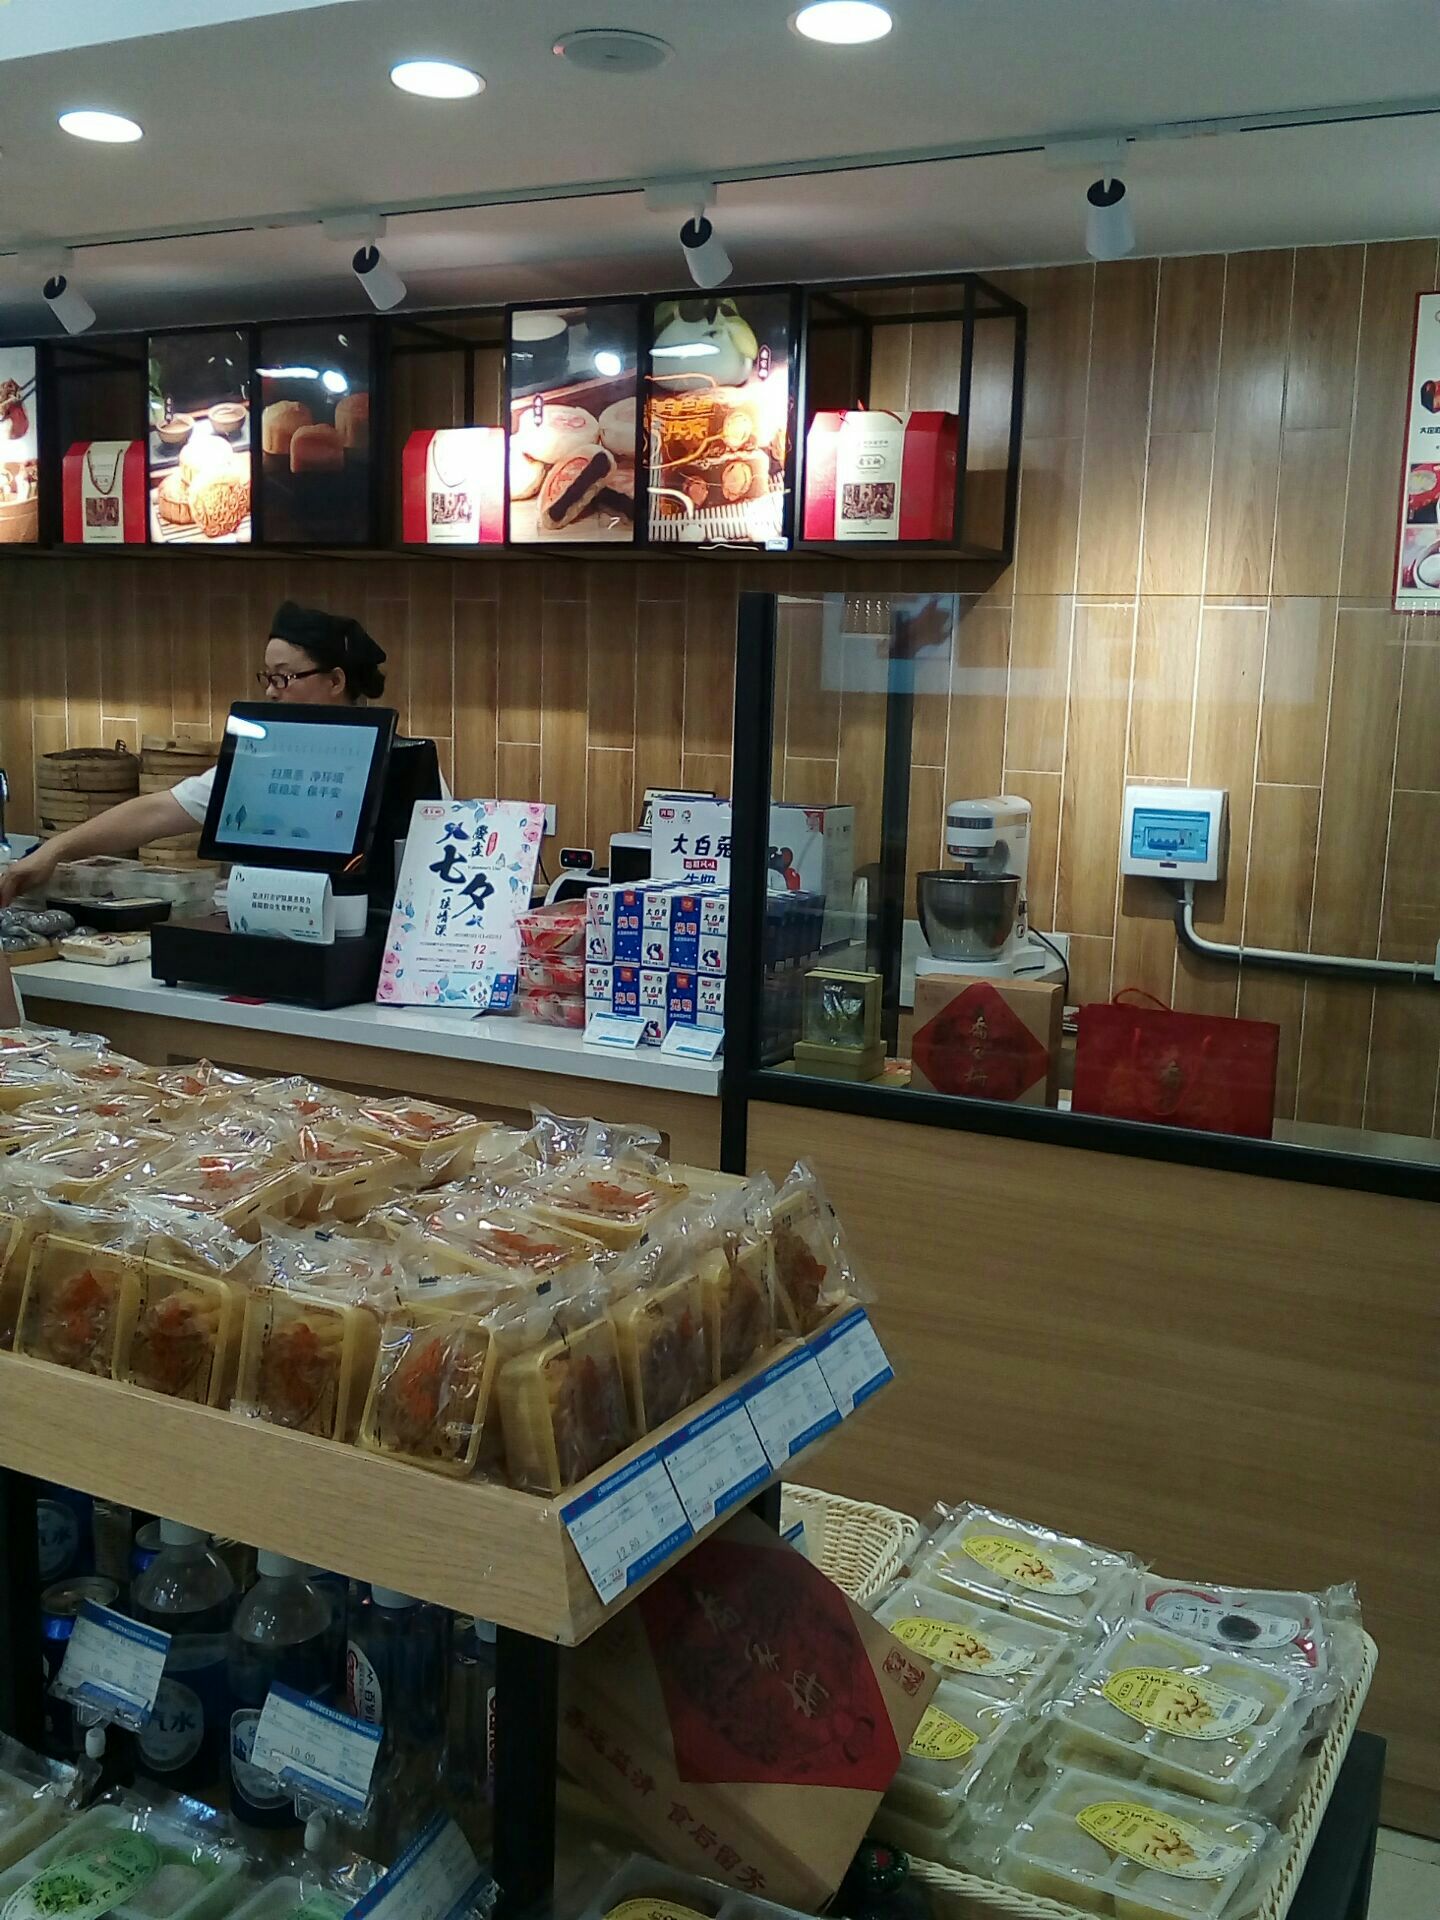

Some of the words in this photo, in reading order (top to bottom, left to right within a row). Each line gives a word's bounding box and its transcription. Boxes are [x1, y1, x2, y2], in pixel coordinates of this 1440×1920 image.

[429, 844, 495, 919] 七夕
[617, 915, 639, 929] 光明
[674, 922, 697, 936] 光明
[473, 944, 487, 955] 12
[470, 959, 484, 970] 13
[615, 992, 637, 1005] 光明
[670, 998, 693, 1012] 光明
